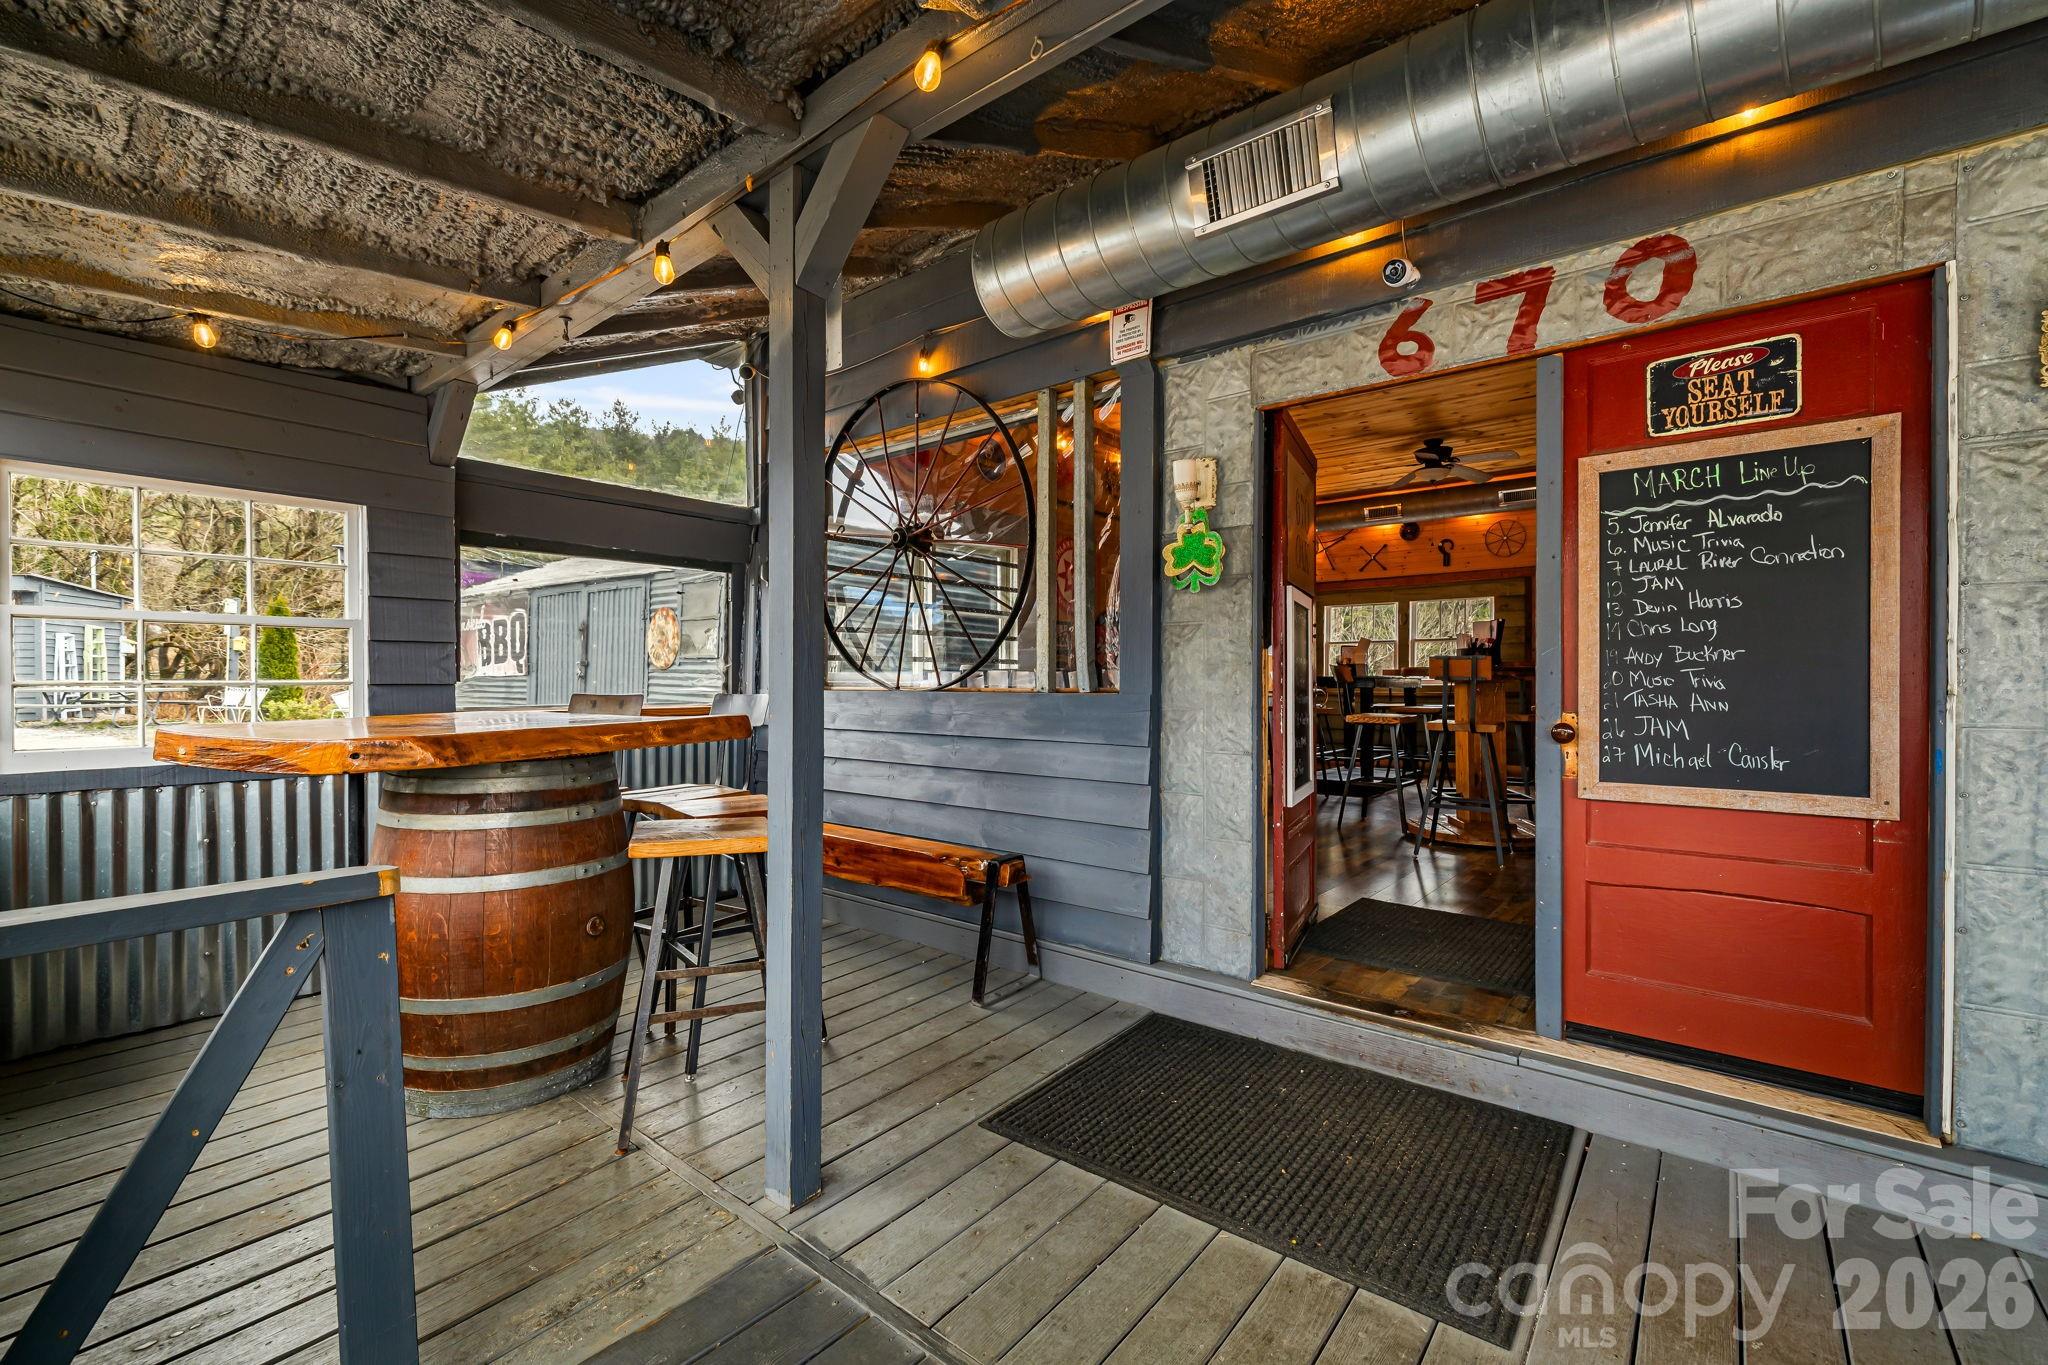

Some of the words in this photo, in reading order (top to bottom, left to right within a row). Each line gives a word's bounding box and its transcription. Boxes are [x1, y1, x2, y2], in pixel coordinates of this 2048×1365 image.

[1378, 234, 1697, 377] 670
[1689, 352, 1754, 378] Please
[1688, 369, 1755, 405] SEAT
[1661, 389, 1785, 430] YOURSELF
[1633, 463, 1721, 498] MARCH
[1784, 456, 1815, 485] Up
[1606, 516, 1624, 535] 5.
[1606, 560, 1622, 576] 7
[1698, 551, 1743, 570] River
[1750, 534, 1845, 565] Connection
[1607, 539, 1627, 556] 6.
[1634, 534, 1691, 554] Music
[1692, 531, 1745, 549] Trivia
[1631, 574, 1684, 594] JAM
[1606, 602, 1624, 618] 13
[1688, 589, 1744, 611] Harris
[478, 609, 527, 674] BBQ
[1626, 619, 1672, 638] Chris
[1680, 616, 1717, 642] Long
[1629, 669, 1675, 689] Music
[1680, 667, 1727, 690] Trivia
[1623, 688, 1679, 709] TASHA
[1690, 692, 1729, 713] ANN
[1633, 715, 1690, 741] JAM
[1602, 745, 1627, 763] 27
[1633, 742, 1713, 771] Michael
